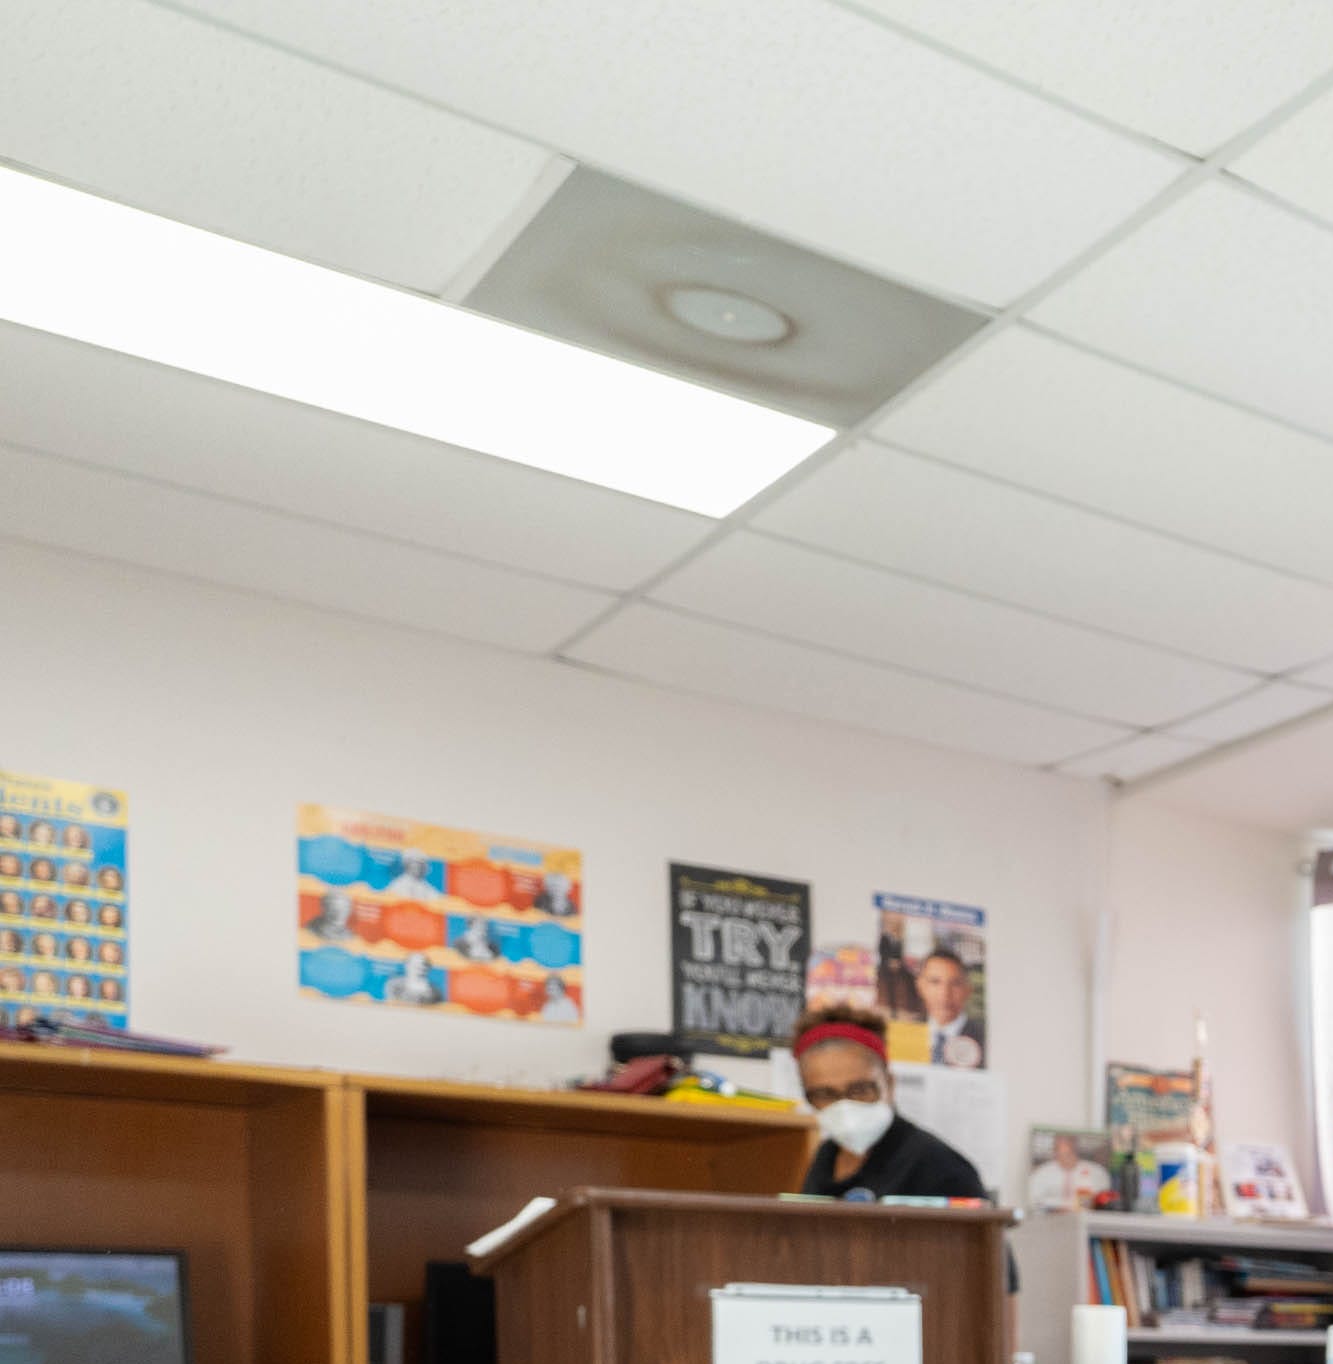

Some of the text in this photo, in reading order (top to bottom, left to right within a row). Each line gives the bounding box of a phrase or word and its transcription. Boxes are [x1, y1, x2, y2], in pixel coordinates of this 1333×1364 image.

[771, 1325, 872, 1344] THIS IS A
